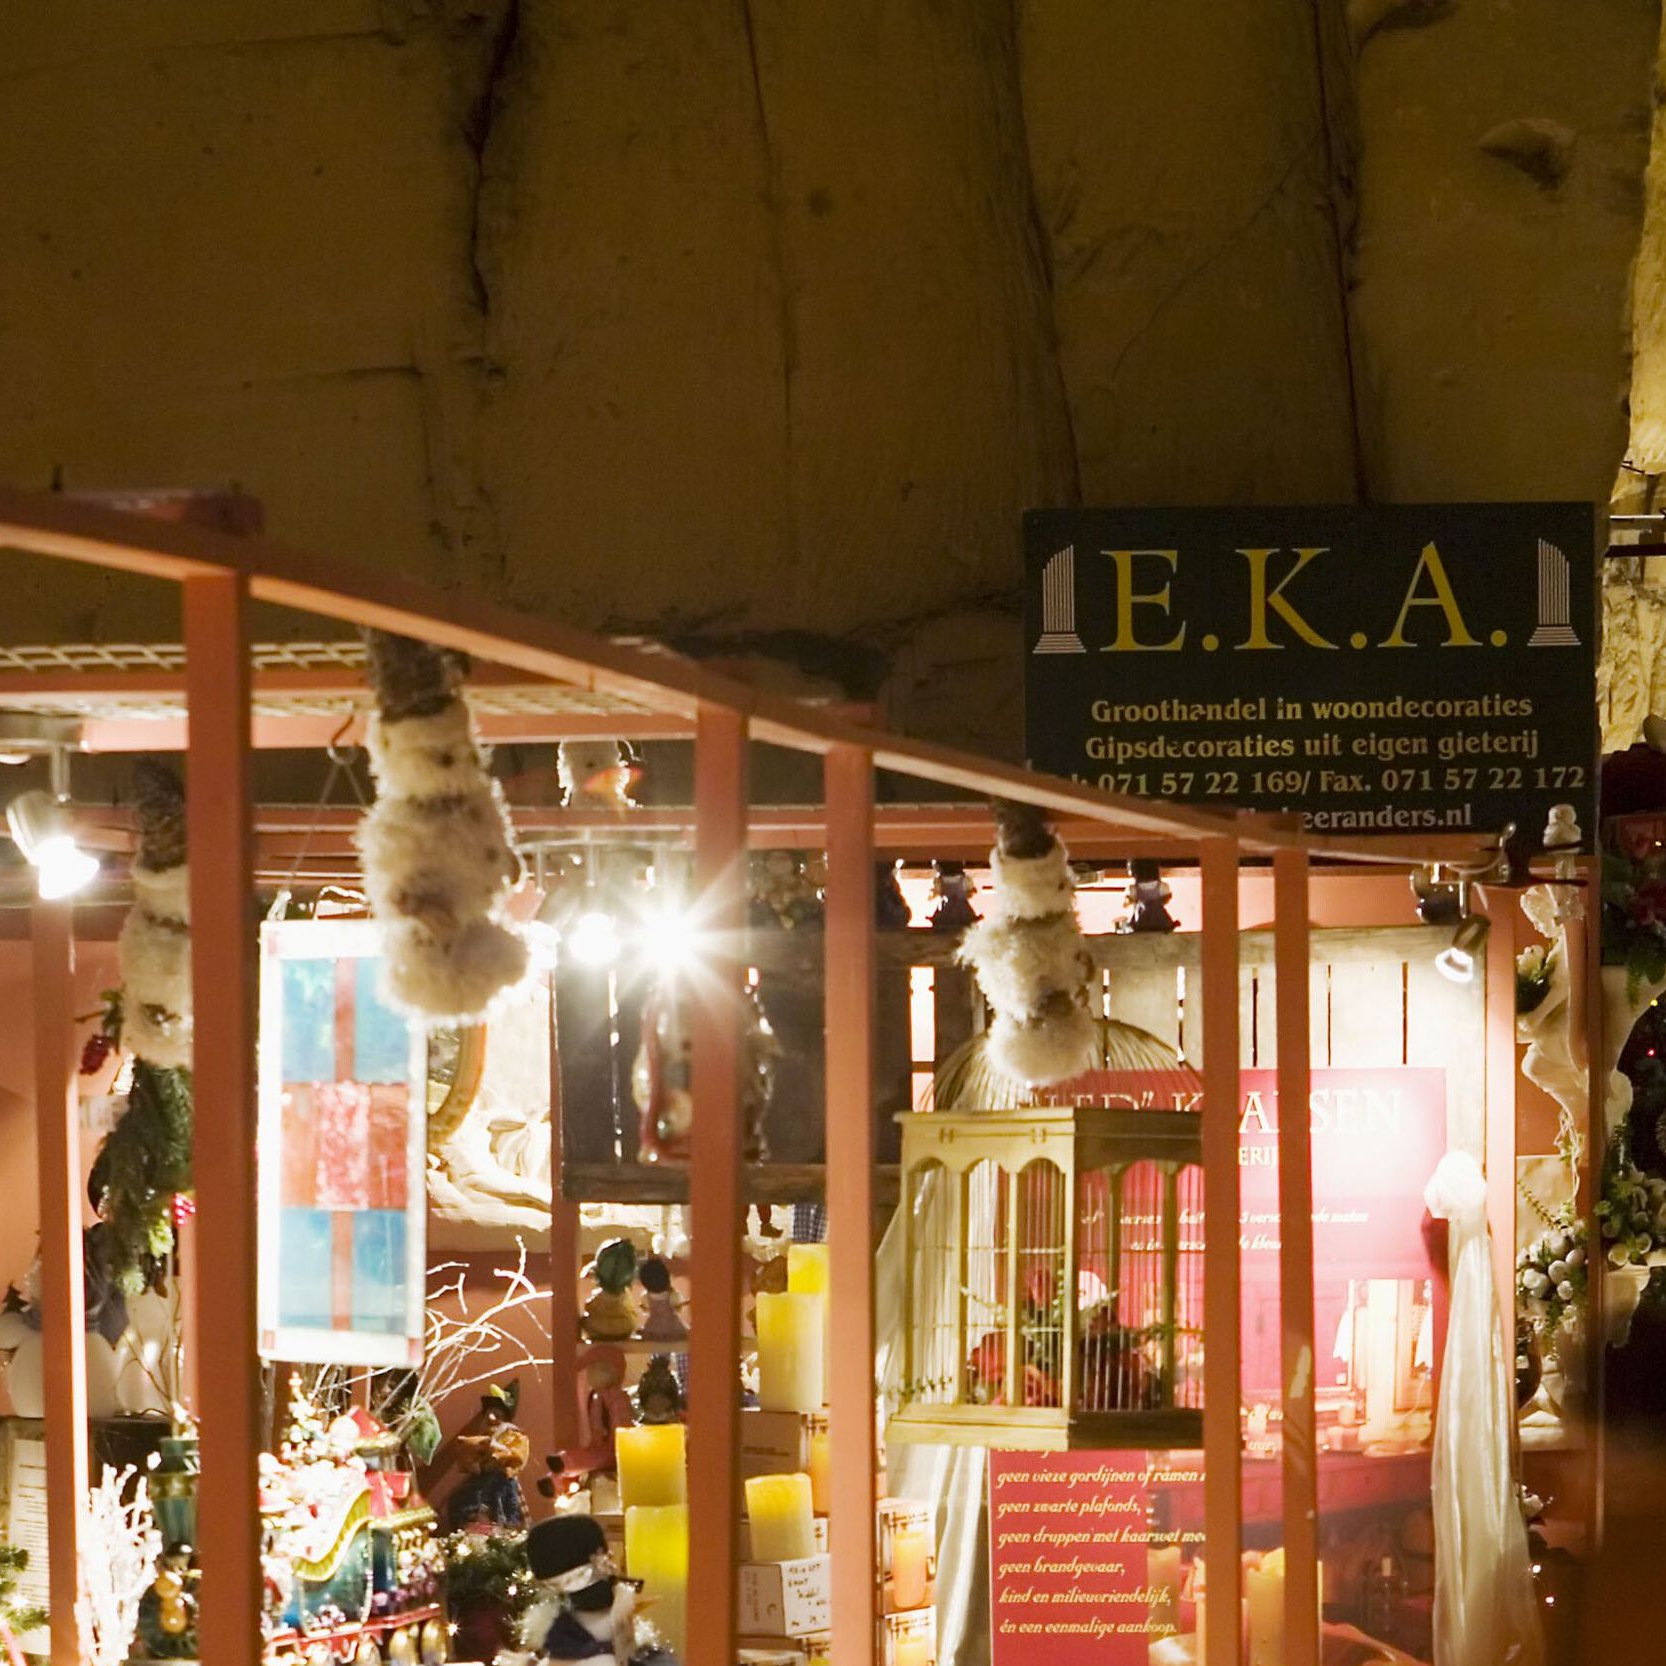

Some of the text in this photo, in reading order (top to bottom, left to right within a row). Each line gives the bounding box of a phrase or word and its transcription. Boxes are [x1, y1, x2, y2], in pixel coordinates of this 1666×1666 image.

[1100, 541, 1508, 653] E.K.A.
[1091, 693, 1533, 722] Groothandel in woondecoraties
[1085, 729, 1539, 765] Gipsdecoraties uit eigen gieterij
[1161, 773, 1194, 795] 57
[1205, 772, 1239, 794] 22
[1320, 770, 1372, 793] Fax.
[1382, 768, 1433, 792] 071
[1445, 768, 1478, 790] 57
[1489, 767, 1523, 789] 22
[1534, 766, 1584, 789] 172
[996, 1471, 1030, 1489] geen
[1067, 1465, 1135, 1488] gordijnen
[1137, 1465, 1153, 1488] of
[998, 1495, 1142, 1519] geen zwarte plafonds,
[998, 1532, 1030, 1549] geen
[1032, 1525, 1090, 1547] druppen
[1091, 1529, 1120, 1543] met
[998, 1555, 1126, 1579] geen brandgevaar,
[999, 1586, 1033, 1604] kind
[1033, 1593, 1049, 1604] en
[1019, 1622, 1042, 1633] een
[1044, 1616, 1115, 1639] eenmalige
